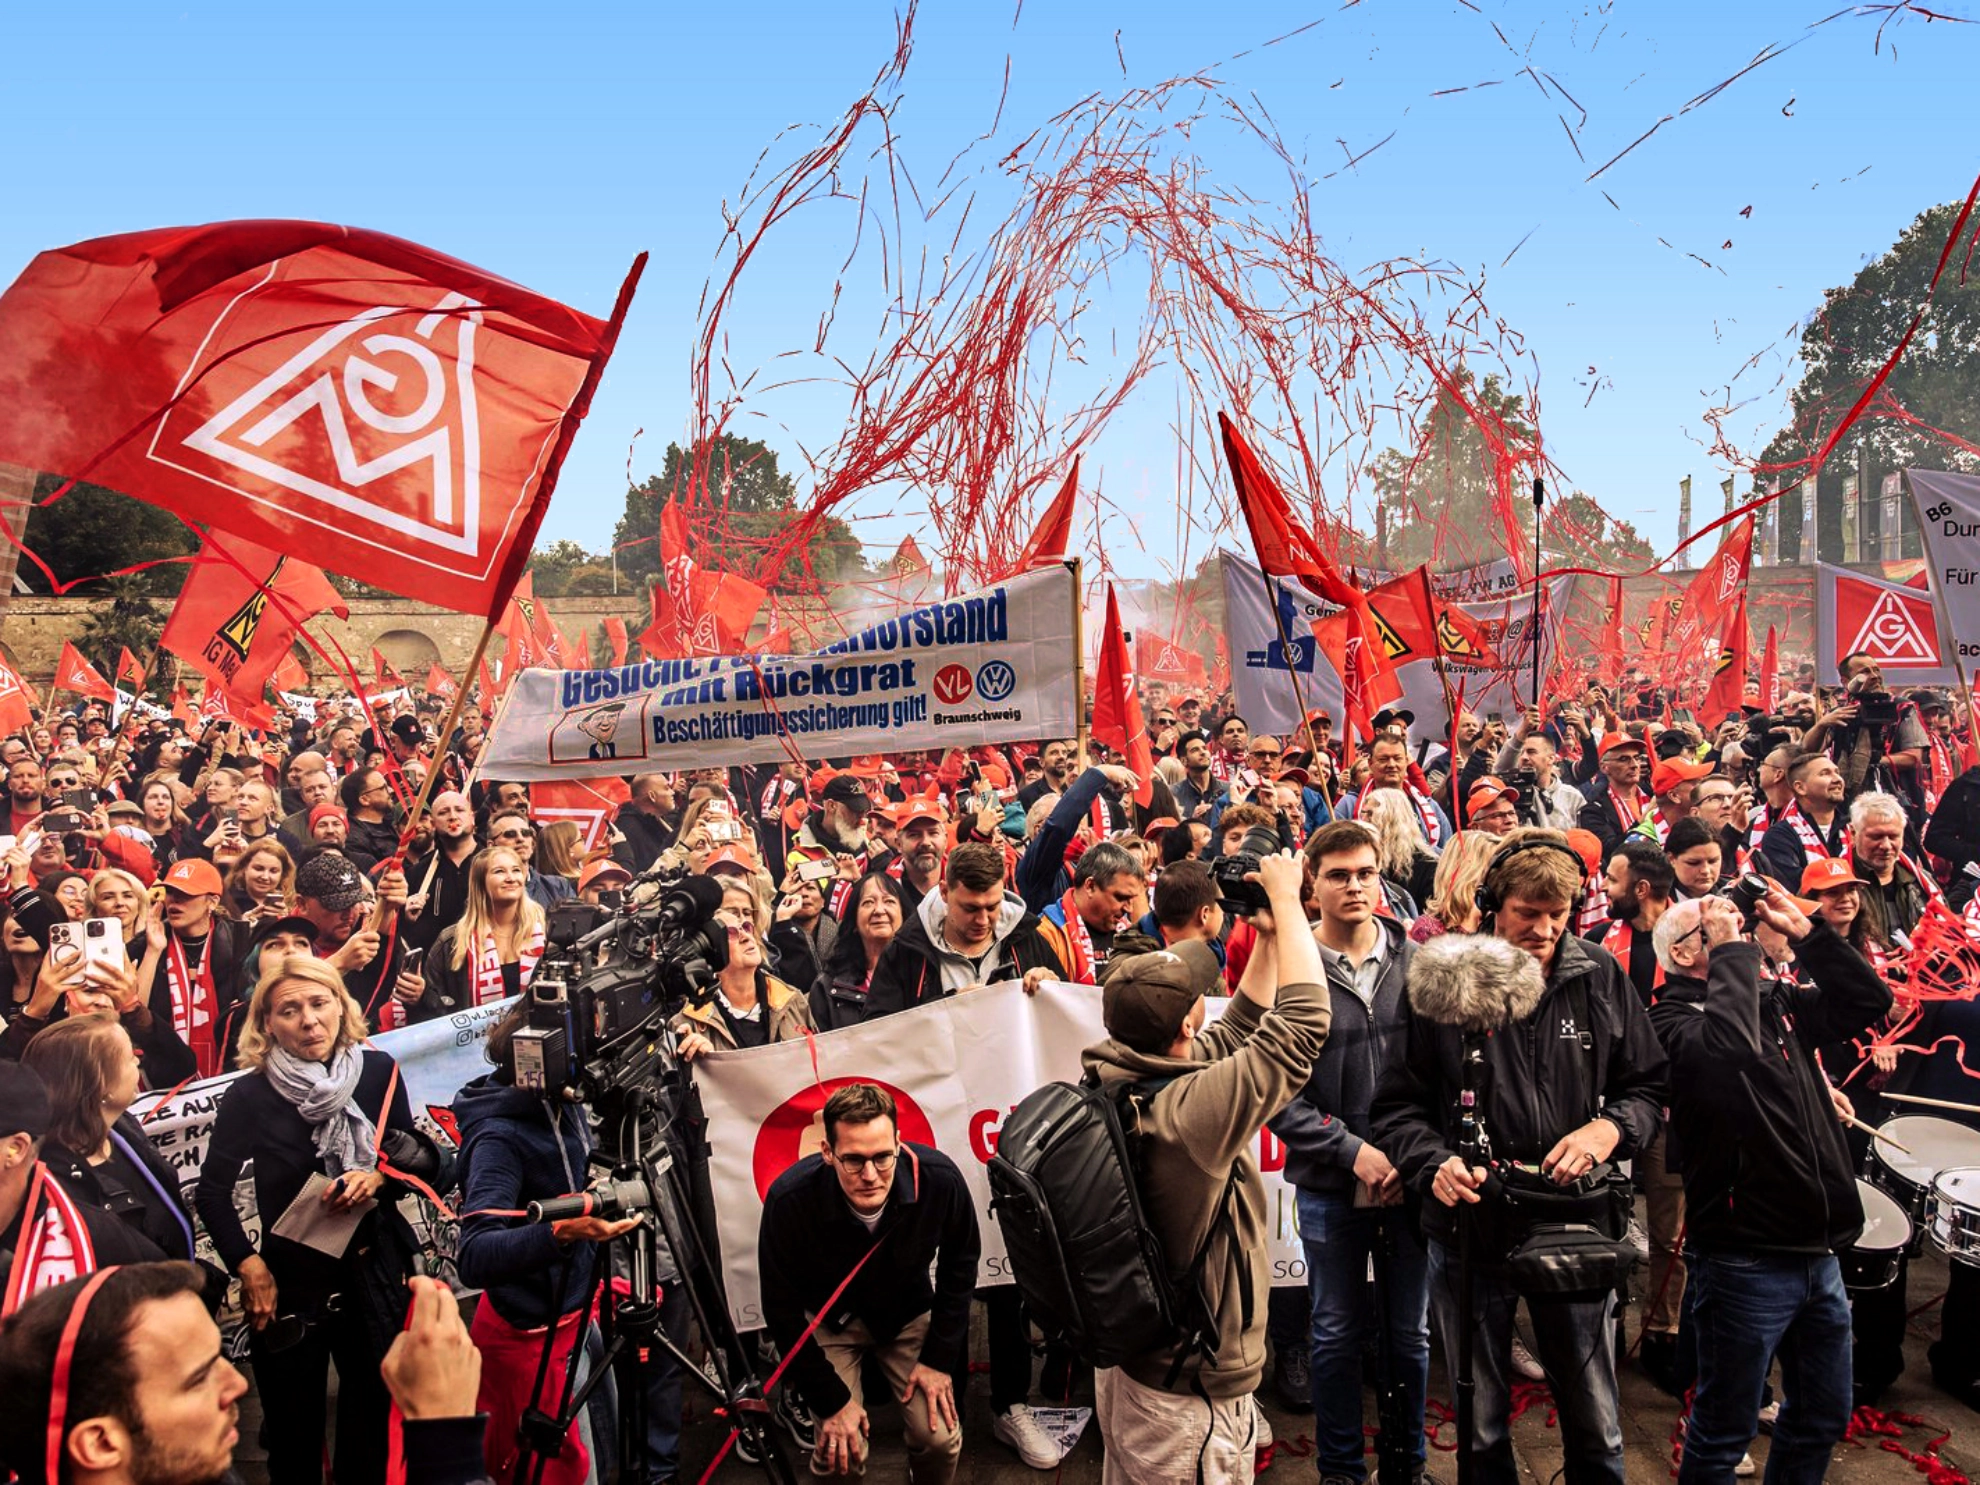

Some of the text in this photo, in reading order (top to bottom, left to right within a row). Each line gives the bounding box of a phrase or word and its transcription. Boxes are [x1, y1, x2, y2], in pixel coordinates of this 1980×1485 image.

[1926, 502, 1952, 522] B6
[1946, 568, 1979, 584] Für
[735, 658, 917, 701] Rückgrat
[653, 694, 928, 744] Beschäftigungssicherung gilt!
[933, 708, 1022, 725] Braunschweig
